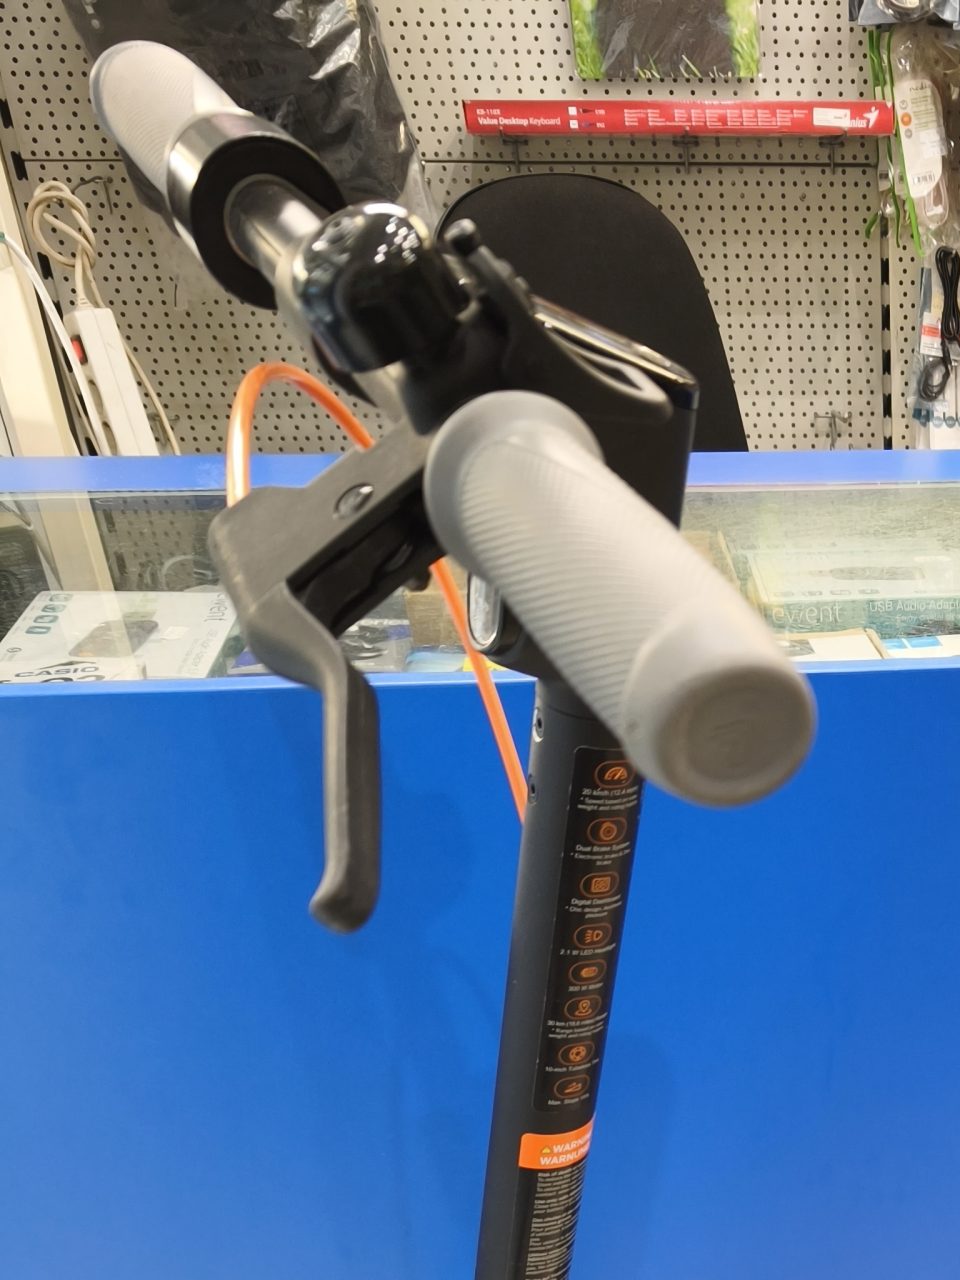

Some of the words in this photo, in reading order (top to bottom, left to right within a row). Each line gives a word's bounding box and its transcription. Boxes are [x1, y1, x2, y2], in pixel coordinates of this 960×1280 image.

[478, 116, 498, 125] Value
[499, 116, 528, 127] Desktop
[529, 117, 561, 126] Keyboard
[869, 600, 893, 613] USB
[896, 598, 926, 612] Audio
[14, 666, 99, 678] CASIO
